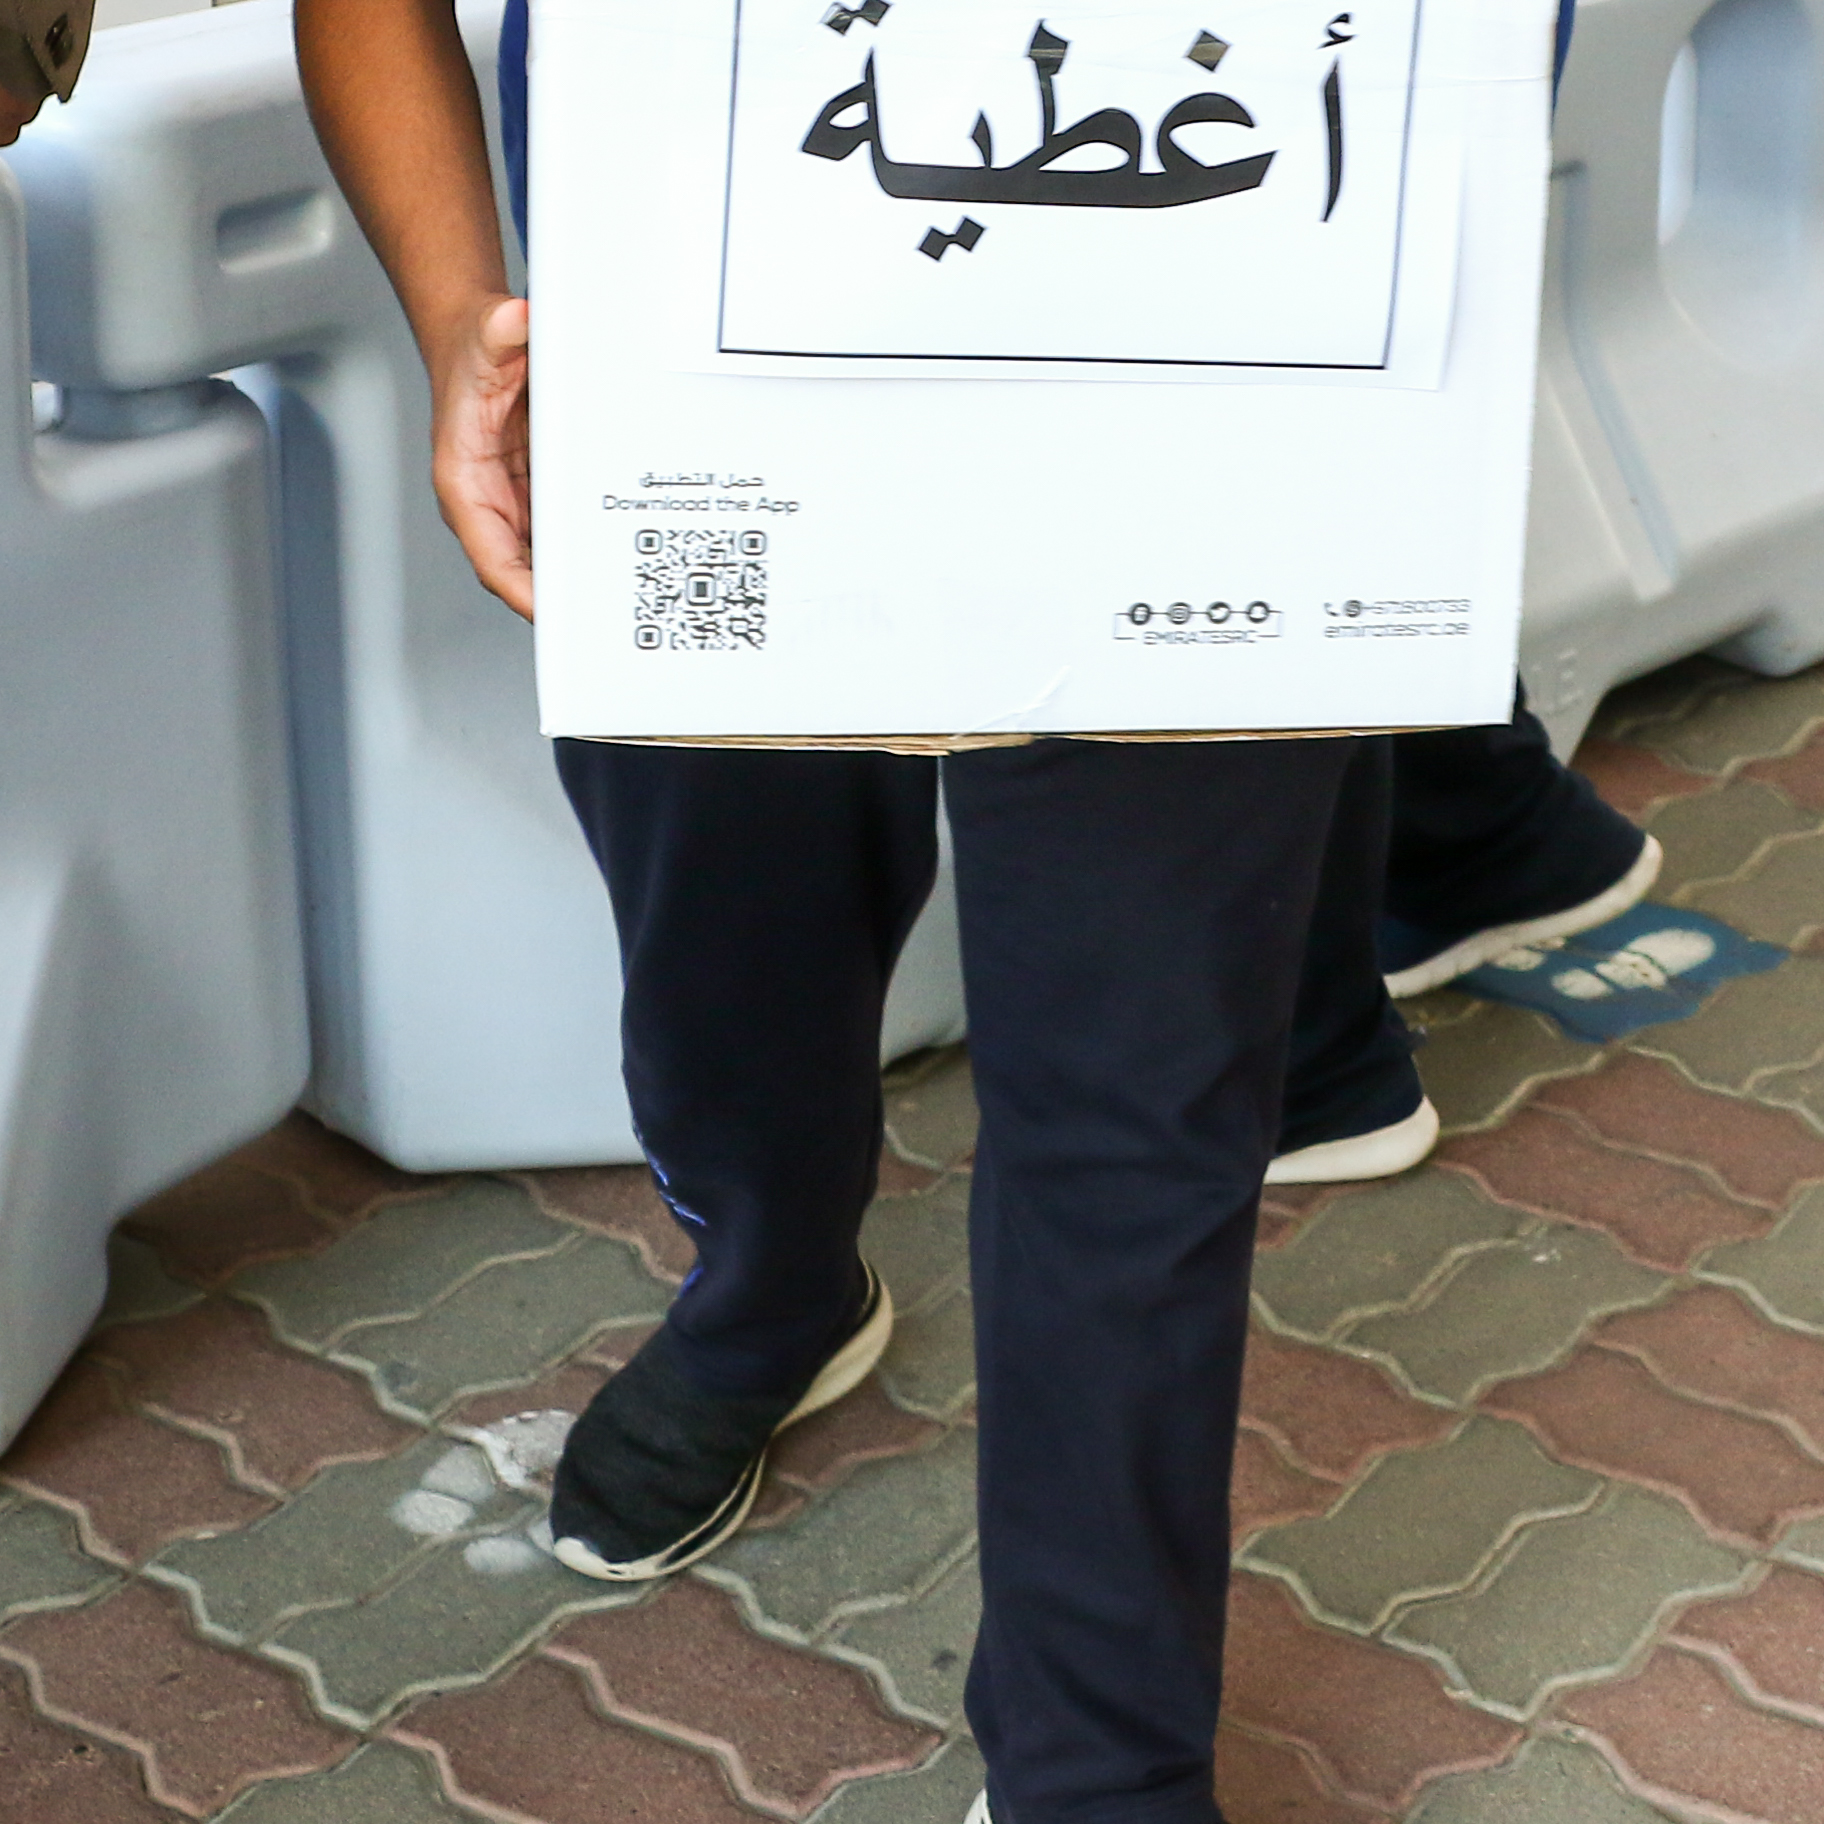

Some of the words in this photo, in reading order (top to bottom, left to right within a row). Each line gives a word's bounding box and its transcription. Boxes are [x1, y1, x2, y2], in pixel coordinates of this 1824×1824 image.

[602, 494, 711, 511] Download
[715, 496, 750, 512] the
[755, 496, 800, 515] App
